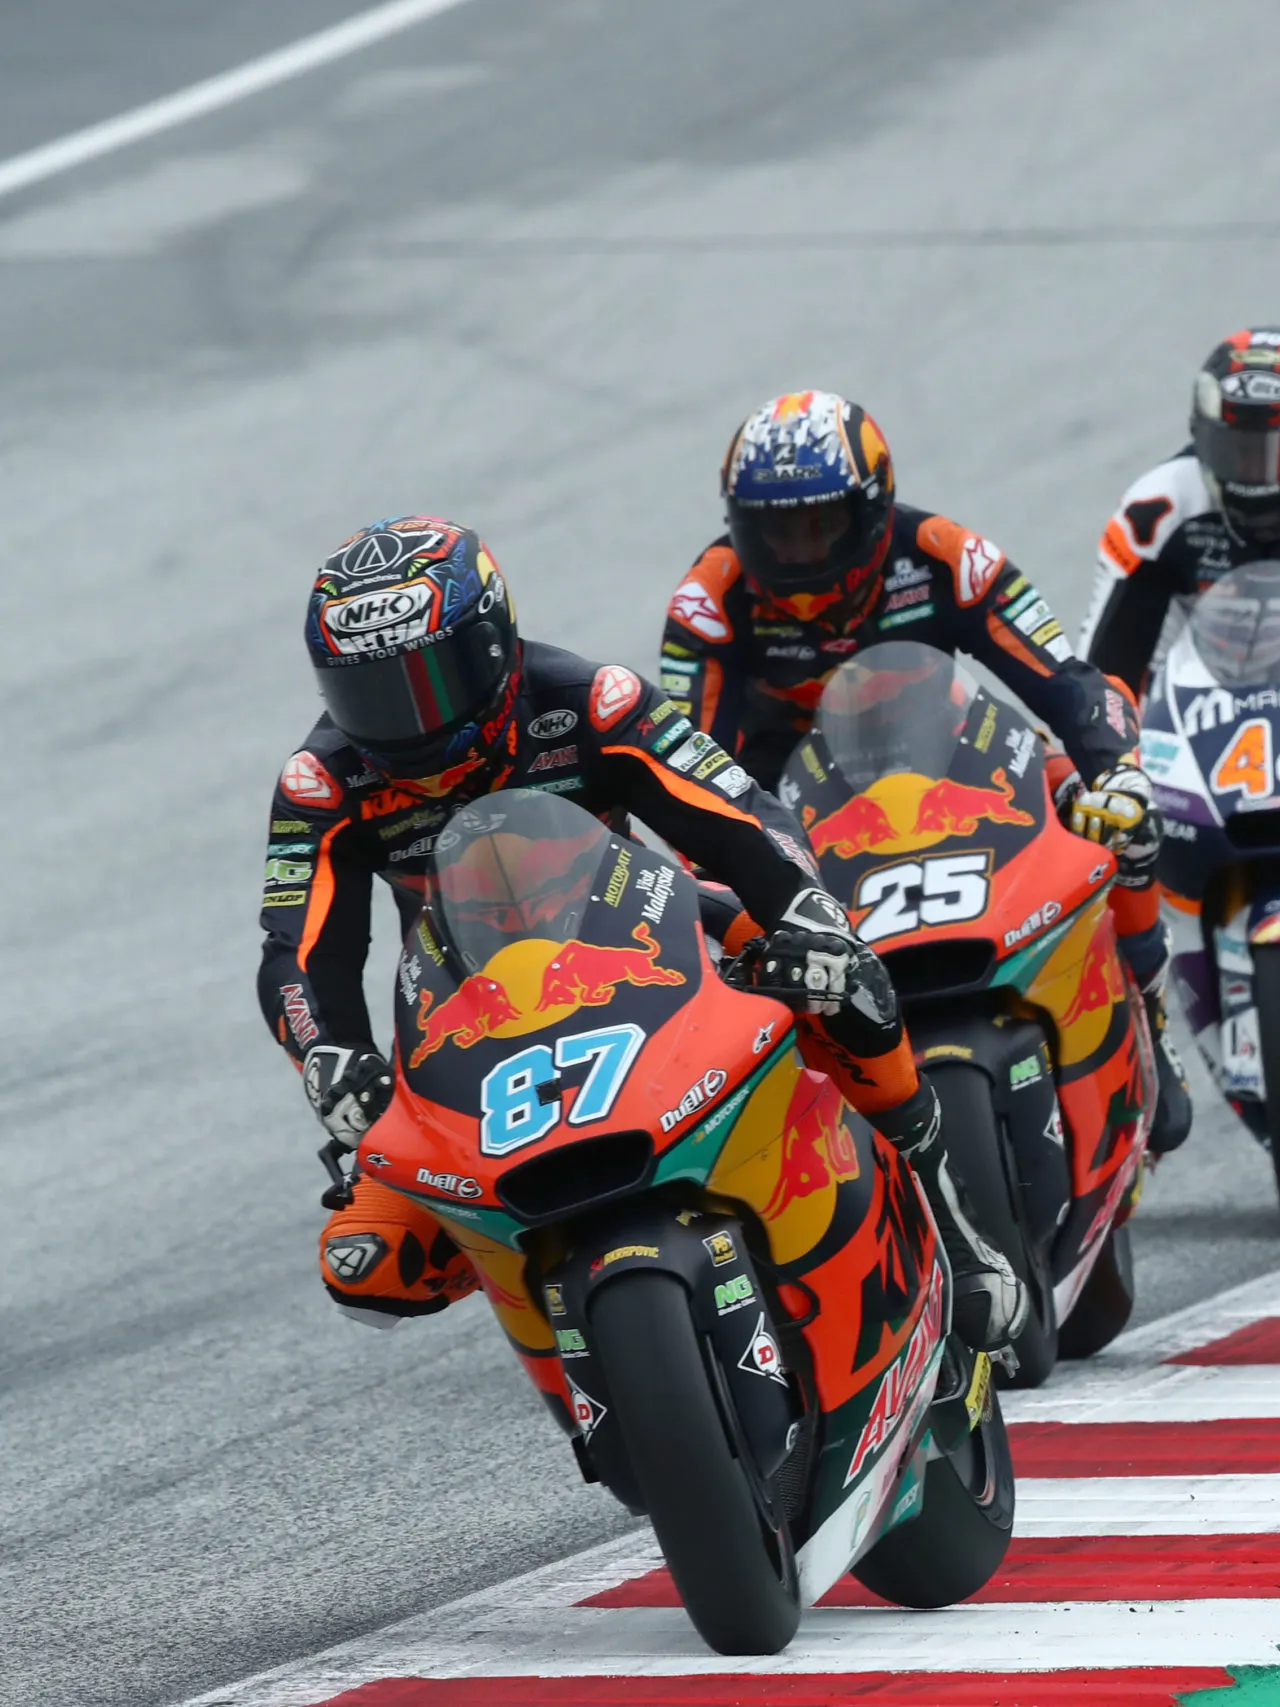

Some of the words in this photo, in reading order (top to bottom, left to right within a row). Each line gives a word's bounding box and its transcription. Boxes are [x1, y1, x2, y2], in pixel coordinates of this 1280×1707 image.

[326, 653, 361, 667] GIVES
[366, 645, 398, 660] YOU
[403, 626, 455, 652] WINGS
[603, 847, 632, 908] MOTOBATT
[635, 869, 656, 891] Visit
[641, 865, 675, 924] Malaysia
[855, 854, 989, 947] 25
[481, 1023, 646, 1155] 87
[714, 1274, 753, 1309] NG
